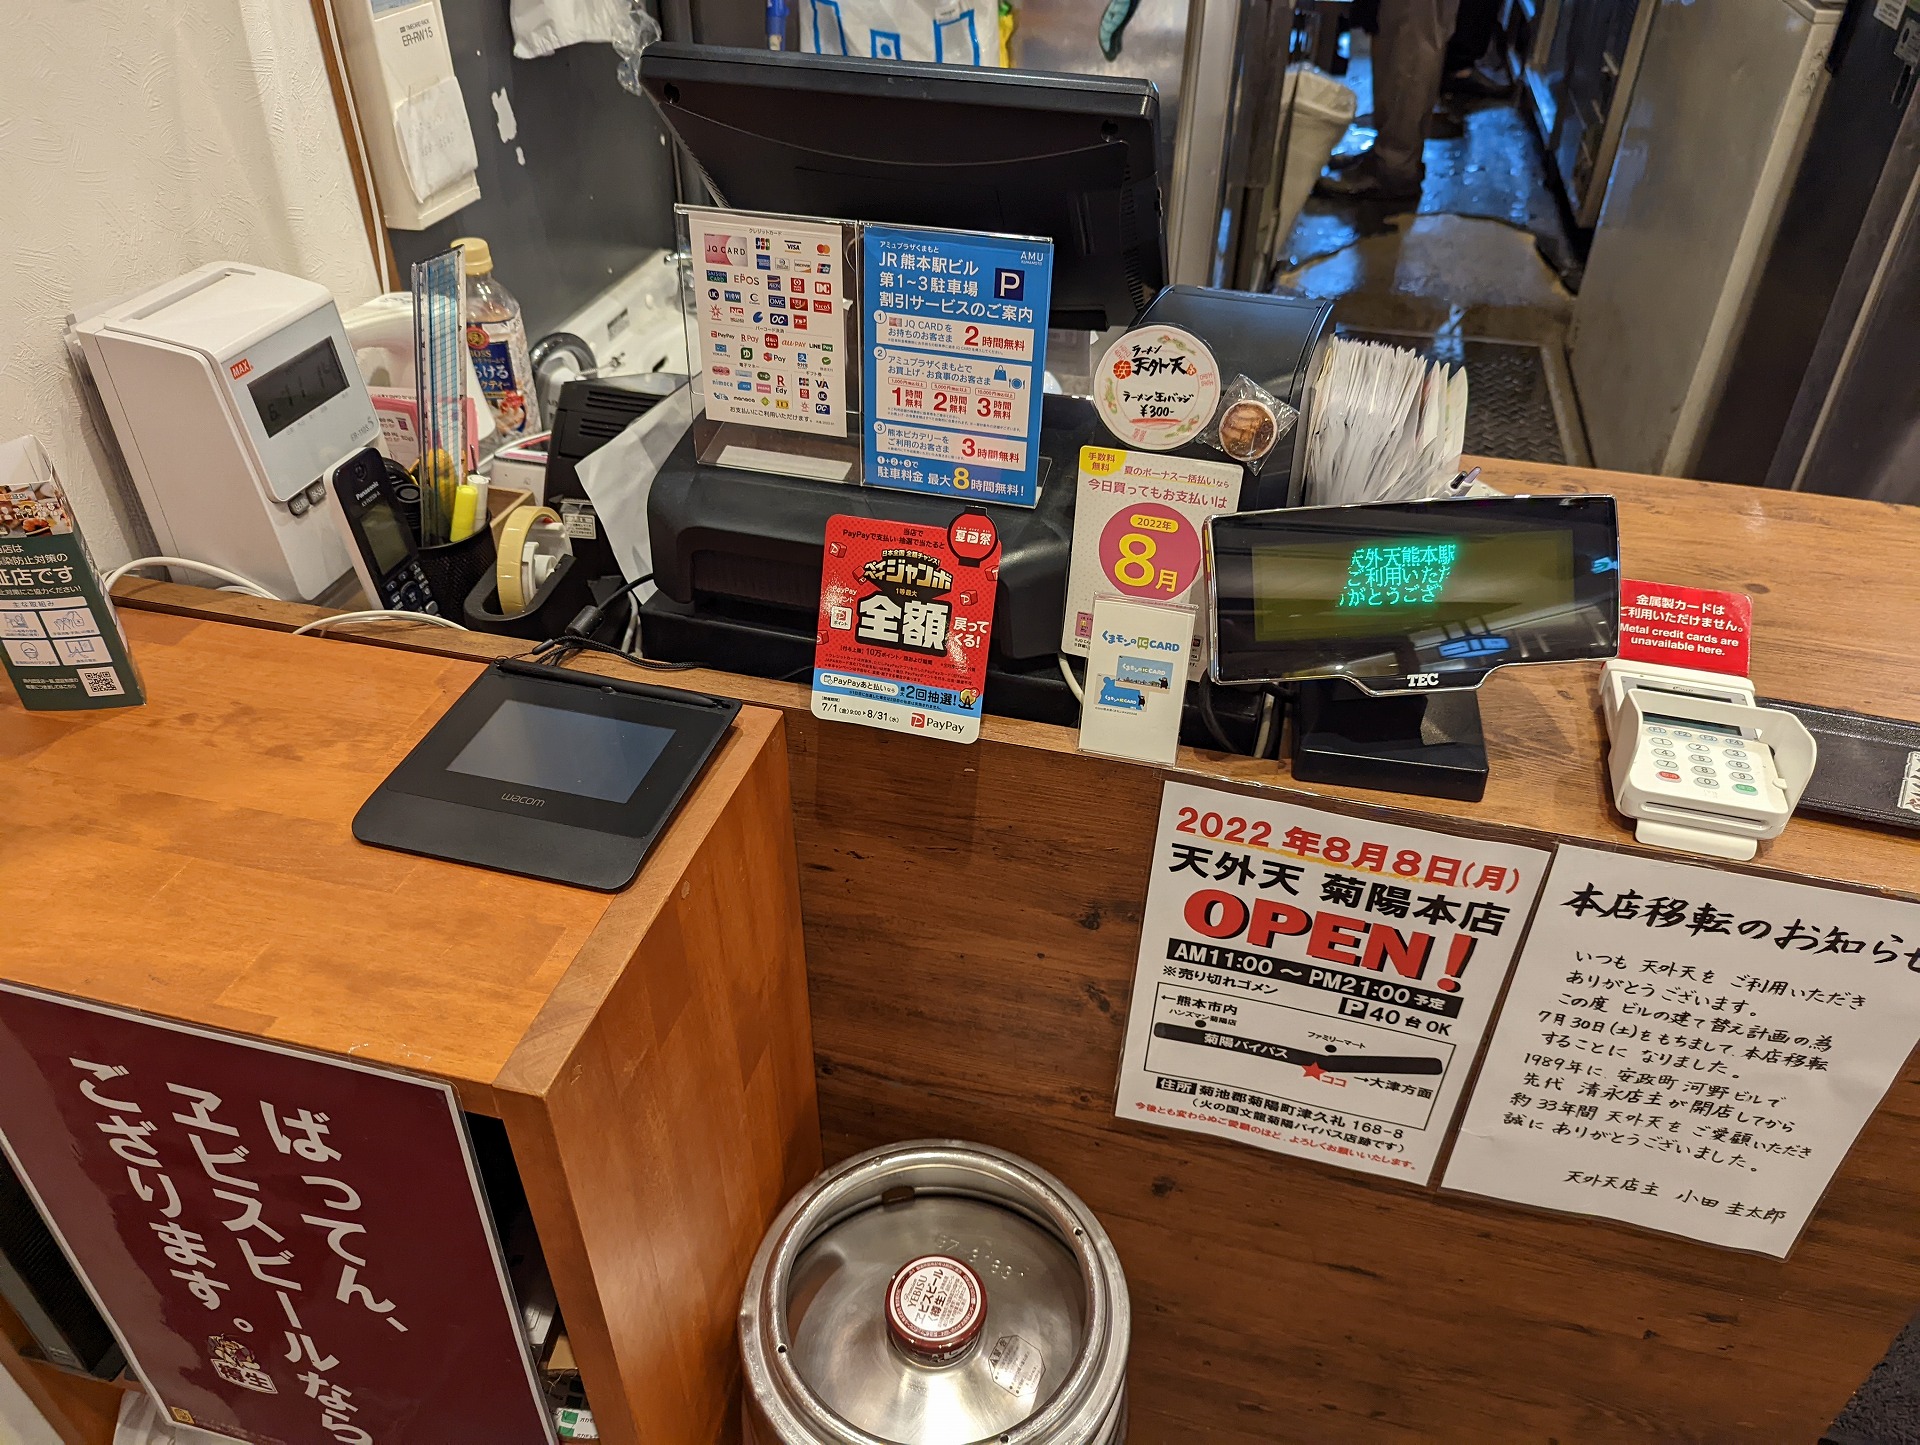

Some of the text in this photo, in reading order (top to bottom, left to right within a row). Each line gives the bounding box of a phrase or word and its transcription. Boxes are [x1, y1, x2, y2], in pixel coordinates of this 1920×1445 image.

[402, 26, 434, 47] ER-RW15
[707, 245, 746, 256] JQ CARD
[755, 237, 771, 251] JCB
[880, 240, 940, 254] アミュプラザくまもと
[1020, 251, 1044, 261] AMU
[733, 273, 760, 286] EPOS
[816, 283, 830, 294] DC
[1000, 272, 1020, 297] P
[769, 297, 785, 306] OMC
[879, 291, 1033, 324] 割引サービスのご案内
[717, 331, 735, 340] PayPay
[746, 335, 759, 343] Pay
[888, 328, 953, 343] お持ちのお客さま
[823, 344, 833, 352] Pay
[1132, 344, 1162, 357] ラーメン
[773, 354, 786, 363] Pay
[888, 355, 973, 373] アミュプラザくまもとで
[1131, 355, 1188, 377] 天外天
[231, 360, 251, 378] MAX
[888, 365, 991, 386] お買上げ・お食事のお客さま
[775, 387, 788, 395] Edy
[892, 387, 923, 407] 1 時間
[905, 398, 923, 409] 無料
[933, 391, 968, 413] 2 時間
[949, 404, 968, 415] 無料
[976, 397, 1012, 418] 3 時間
[730, 406, 813, 423] お支払いにご利用いただけます。
[993, 410, 1011, 421] 無料
[887, 428, 949, 445] 熊本ピカデリーを
[888, 438, 950, 453] ご利用のお客さま
[1088, 452, 1116, 463] 手数料
[877, 466, 924, 483] 駐車料金
[1091, 462, 1110, 472] 無料
[1124, 465, 1230, 489] 夏のボーナス一括払いなら
[355, 481, 379, 501] Panasonic
[1088, 478, 1228, 509] 今日買ってもお支払いは
[903, 528, 924, 537] 当店で
[1137, 516, 1172, 531] 2022年
[882, 549, 905, 557] 日本全国
[886, 558, 952, 590] ジャンボ
[1635, 594, 1725, 616] 金属製カードは
[859, 594, 949, 651] 全額
[953, 616, 990, 634] 戻って
[1620, 622, 1739, 647] Metal credit cards are
[1149, 640, 1180, 652] CARD
[1631, 636, 1726, 656] unavailable here.
[833, 676, 896, 694] PayPayあと払いなら
[1407, 673, 1440, 687] TEC
[906, 686, 957, 706] 2回抽選!
[926, 717, 965, 734] PayPay
[501, 791, 545, 808] wacom
[1168, 842, 1511, 937] 天外天 菊陽本店
[1162, 965, 1279, 995] ※売り切れゴメン
[1174, 943, 1446, 1011] AM11:00 PM21:00 予定
[1576, 951, 1867, 1010] いつも 天外天を ご利用いただき
[1176, 994, 1238, 1015] 熊本市内
[1558, 993, 1610, 1013] この度
[1169, 1008, 1238, 1026] ハンズマン菊陽店
[1426, 1020, 1452, 1037] OK
[1203, 1032, 1289, 1059] 菊陽バイパス
[1307, 1031, 1366, 1049] ファミリーマート
[1321, 1074, 1348, 1088] ココ
[1368, 1077, 1434, 1100] 大津方面
[1159, 1079, 1404, 1140] 住所 菊池郡菊陽町津久礼 168-8
[1563, 1170, 1660, 1197] 天外天店主
[68, 1057, 254, 1333] ございます。
[259, 1099, 409, 1332] ばってん、
[907, 1274, 928, 1308] YEBISU
